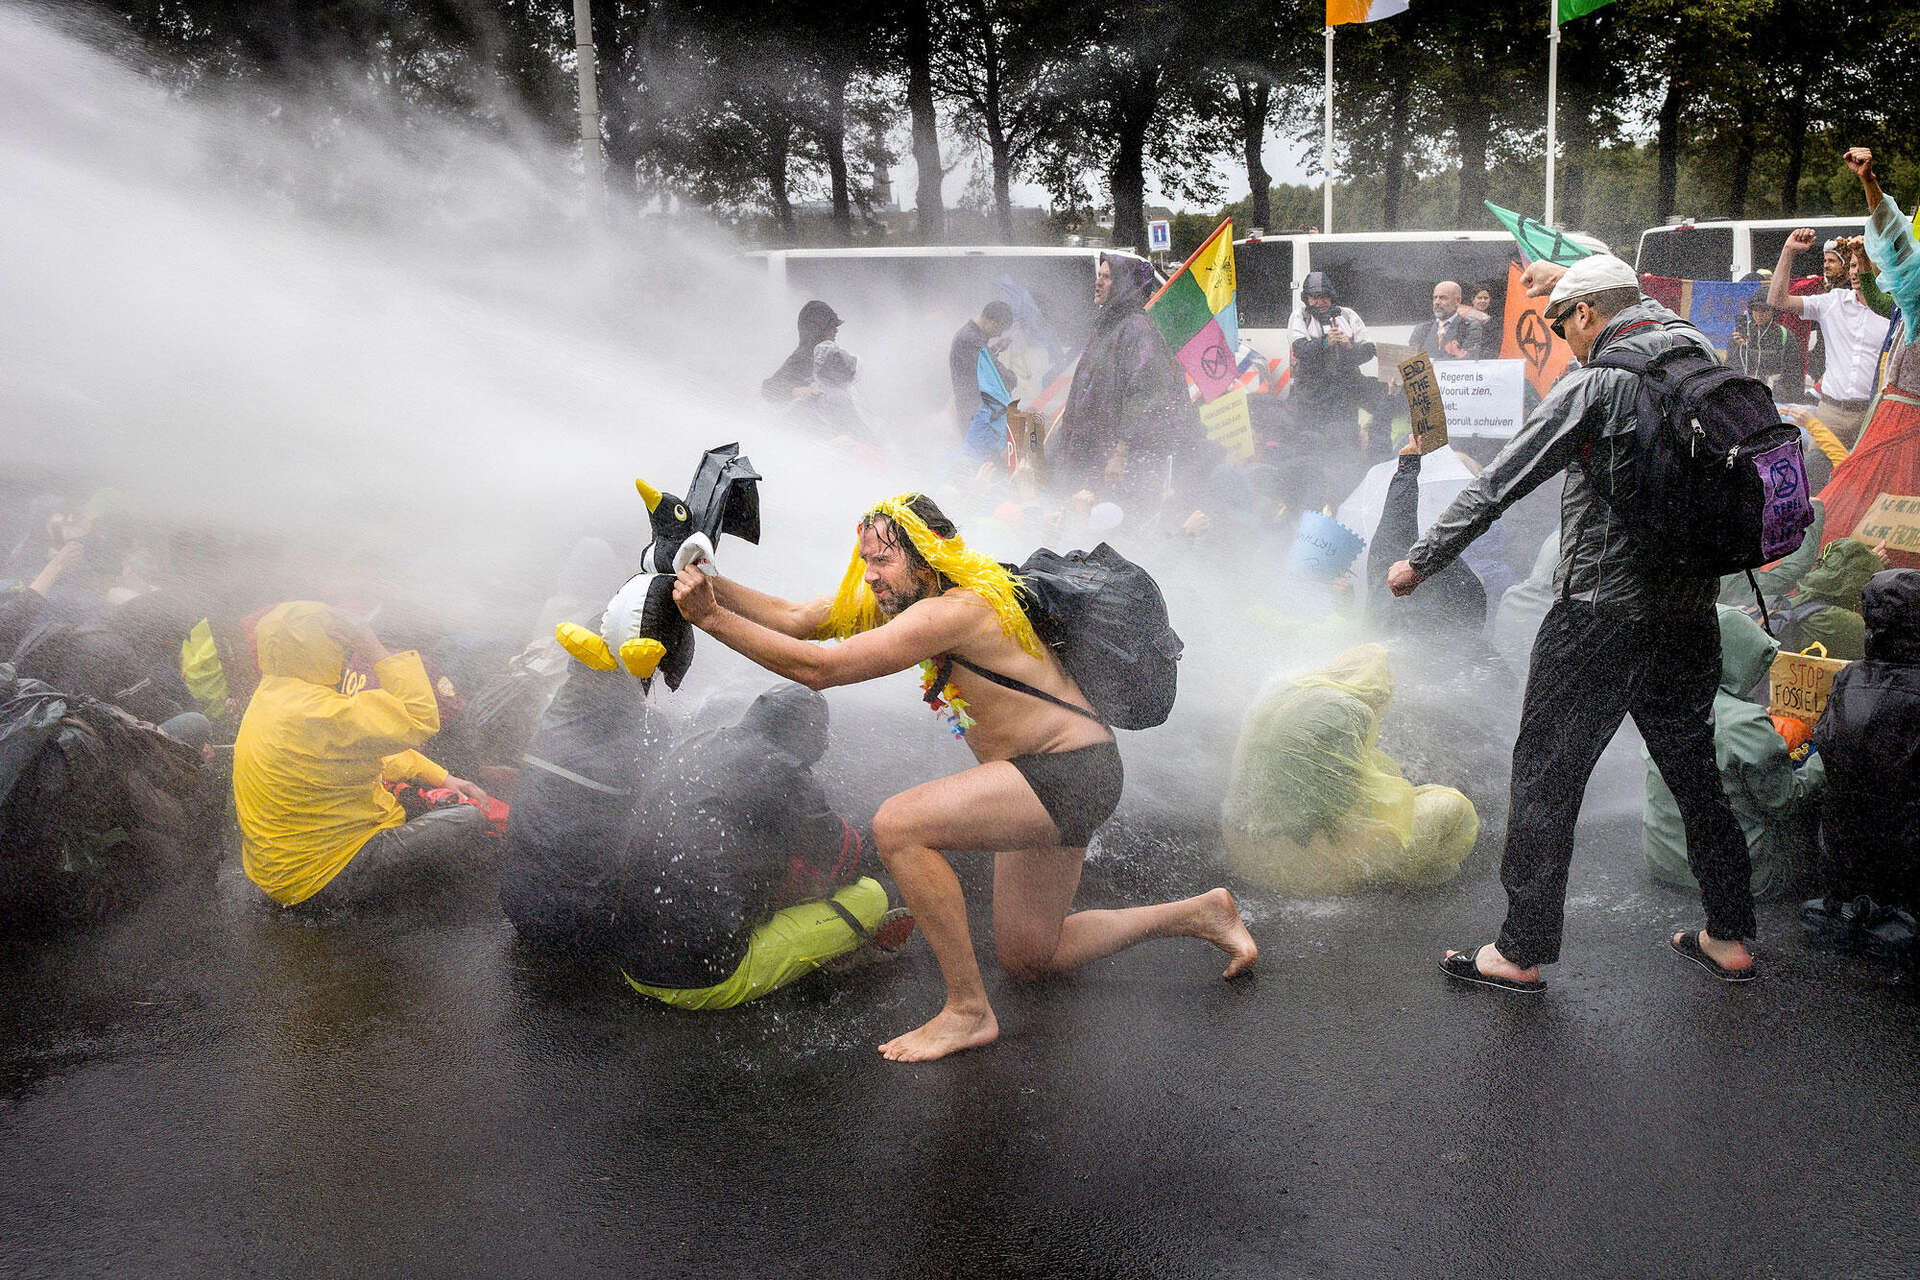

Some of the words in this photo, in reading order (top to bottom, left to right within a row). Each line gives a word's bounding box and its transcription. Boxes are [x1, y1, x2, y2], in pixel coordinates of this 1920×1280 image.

[1410, 375, 1430, 395] THE
[1440, 372, 1474, 384] Regeren
[1476, 372, 1483, 381] is
[1412, 391, 1429, 409] AGE
[1447, 417, 1471, 427] ooruit
[1474, 417, 1513, 427] schuiven
[1773, 500, 1802, 517] REBEL
[1789, 663, 1825, 690] STOP
[1775, 684, 1832, 713] FOSSIEL
